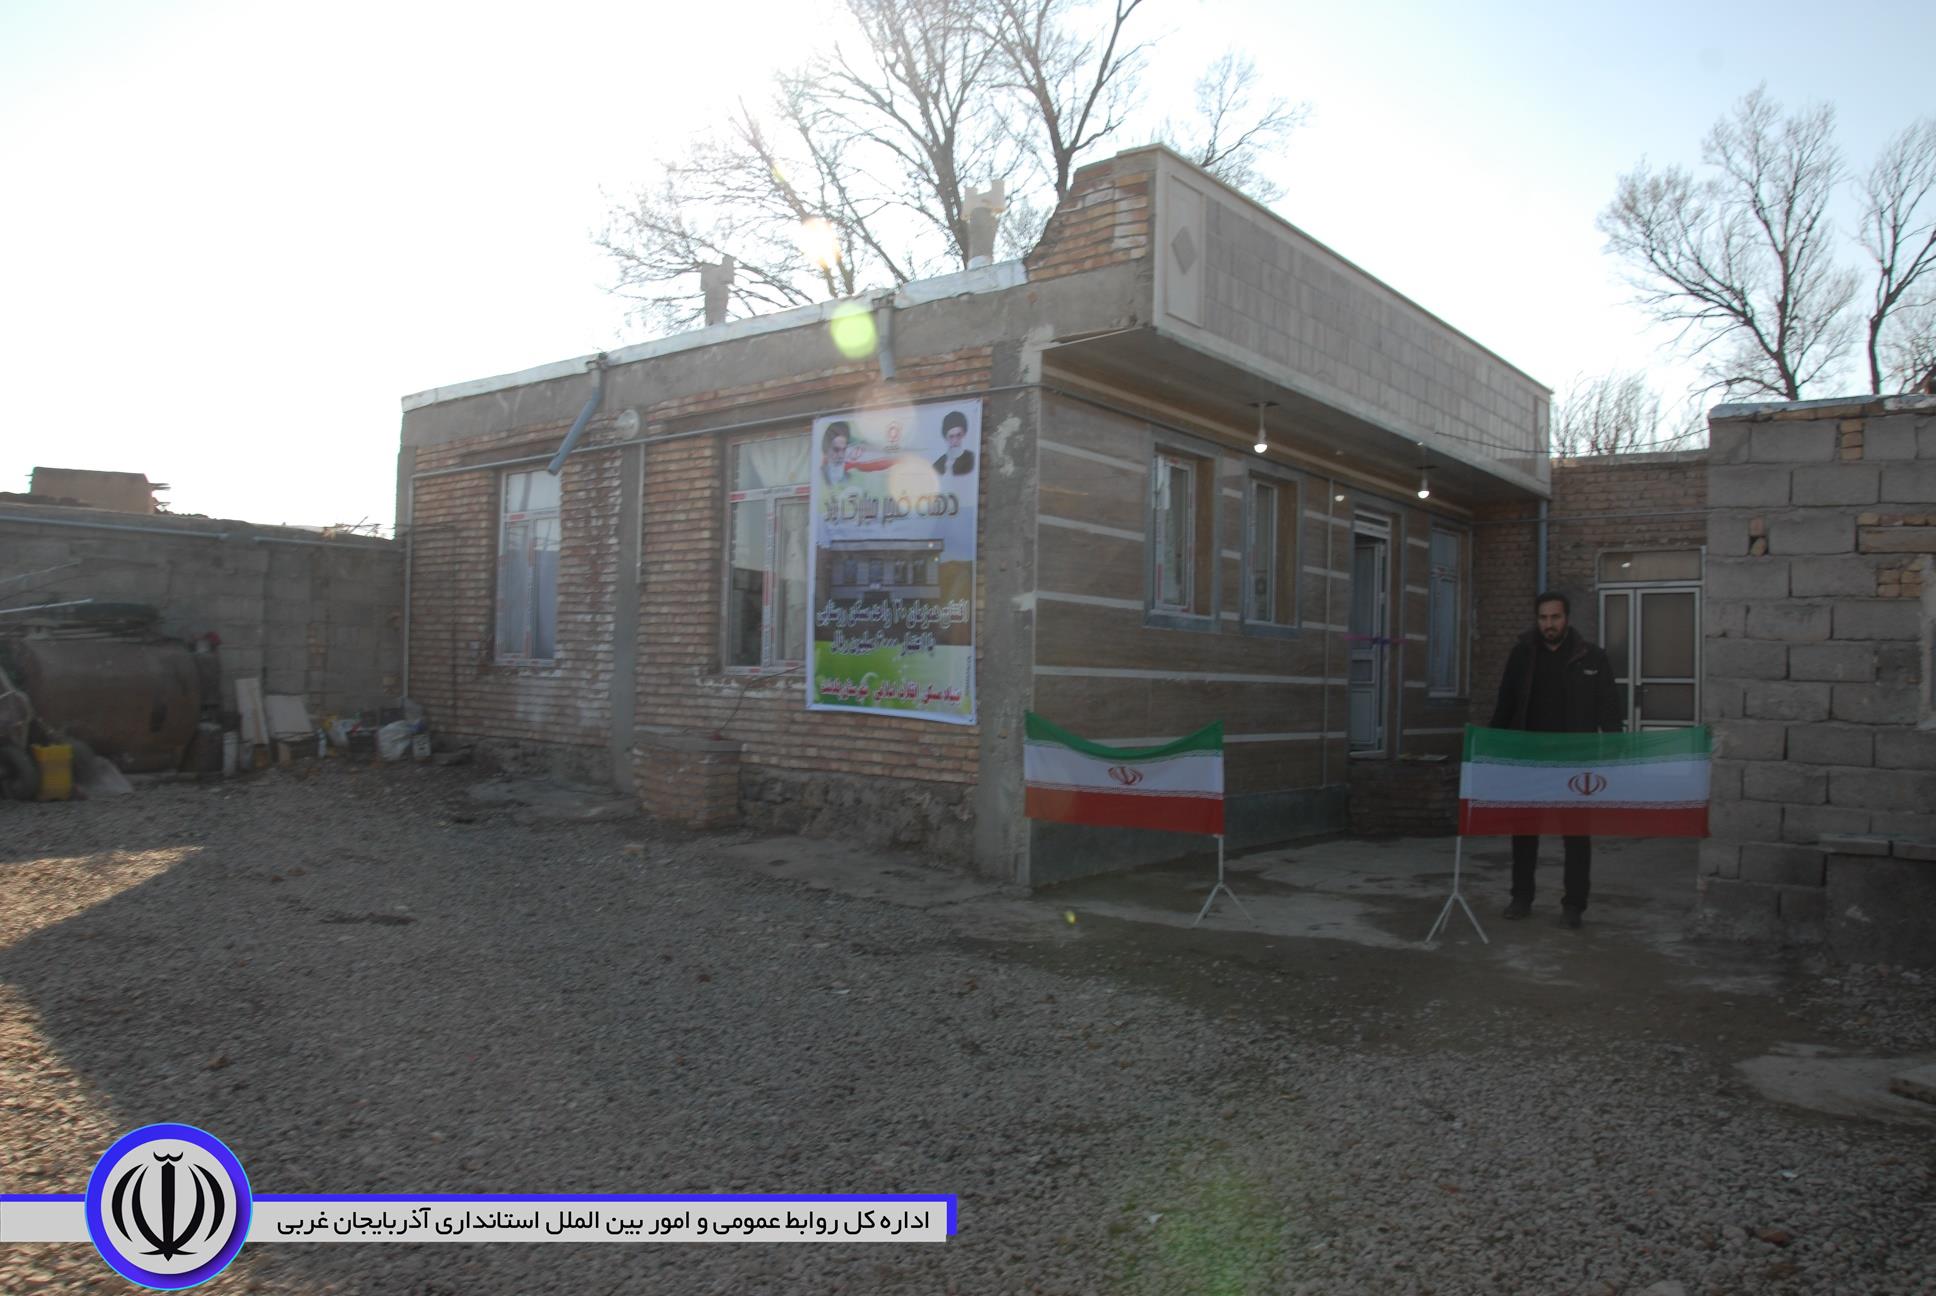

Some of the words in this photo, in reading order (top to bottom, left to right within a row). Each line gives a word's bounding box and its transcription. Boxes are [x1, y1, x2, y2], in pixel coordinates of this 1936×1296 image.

[823, 494, 840, 526] باد
[841, 490, 879, 527] مبارک
[879, 490, 913, 527] فجر
[915, 493, 959, 518] دهه
